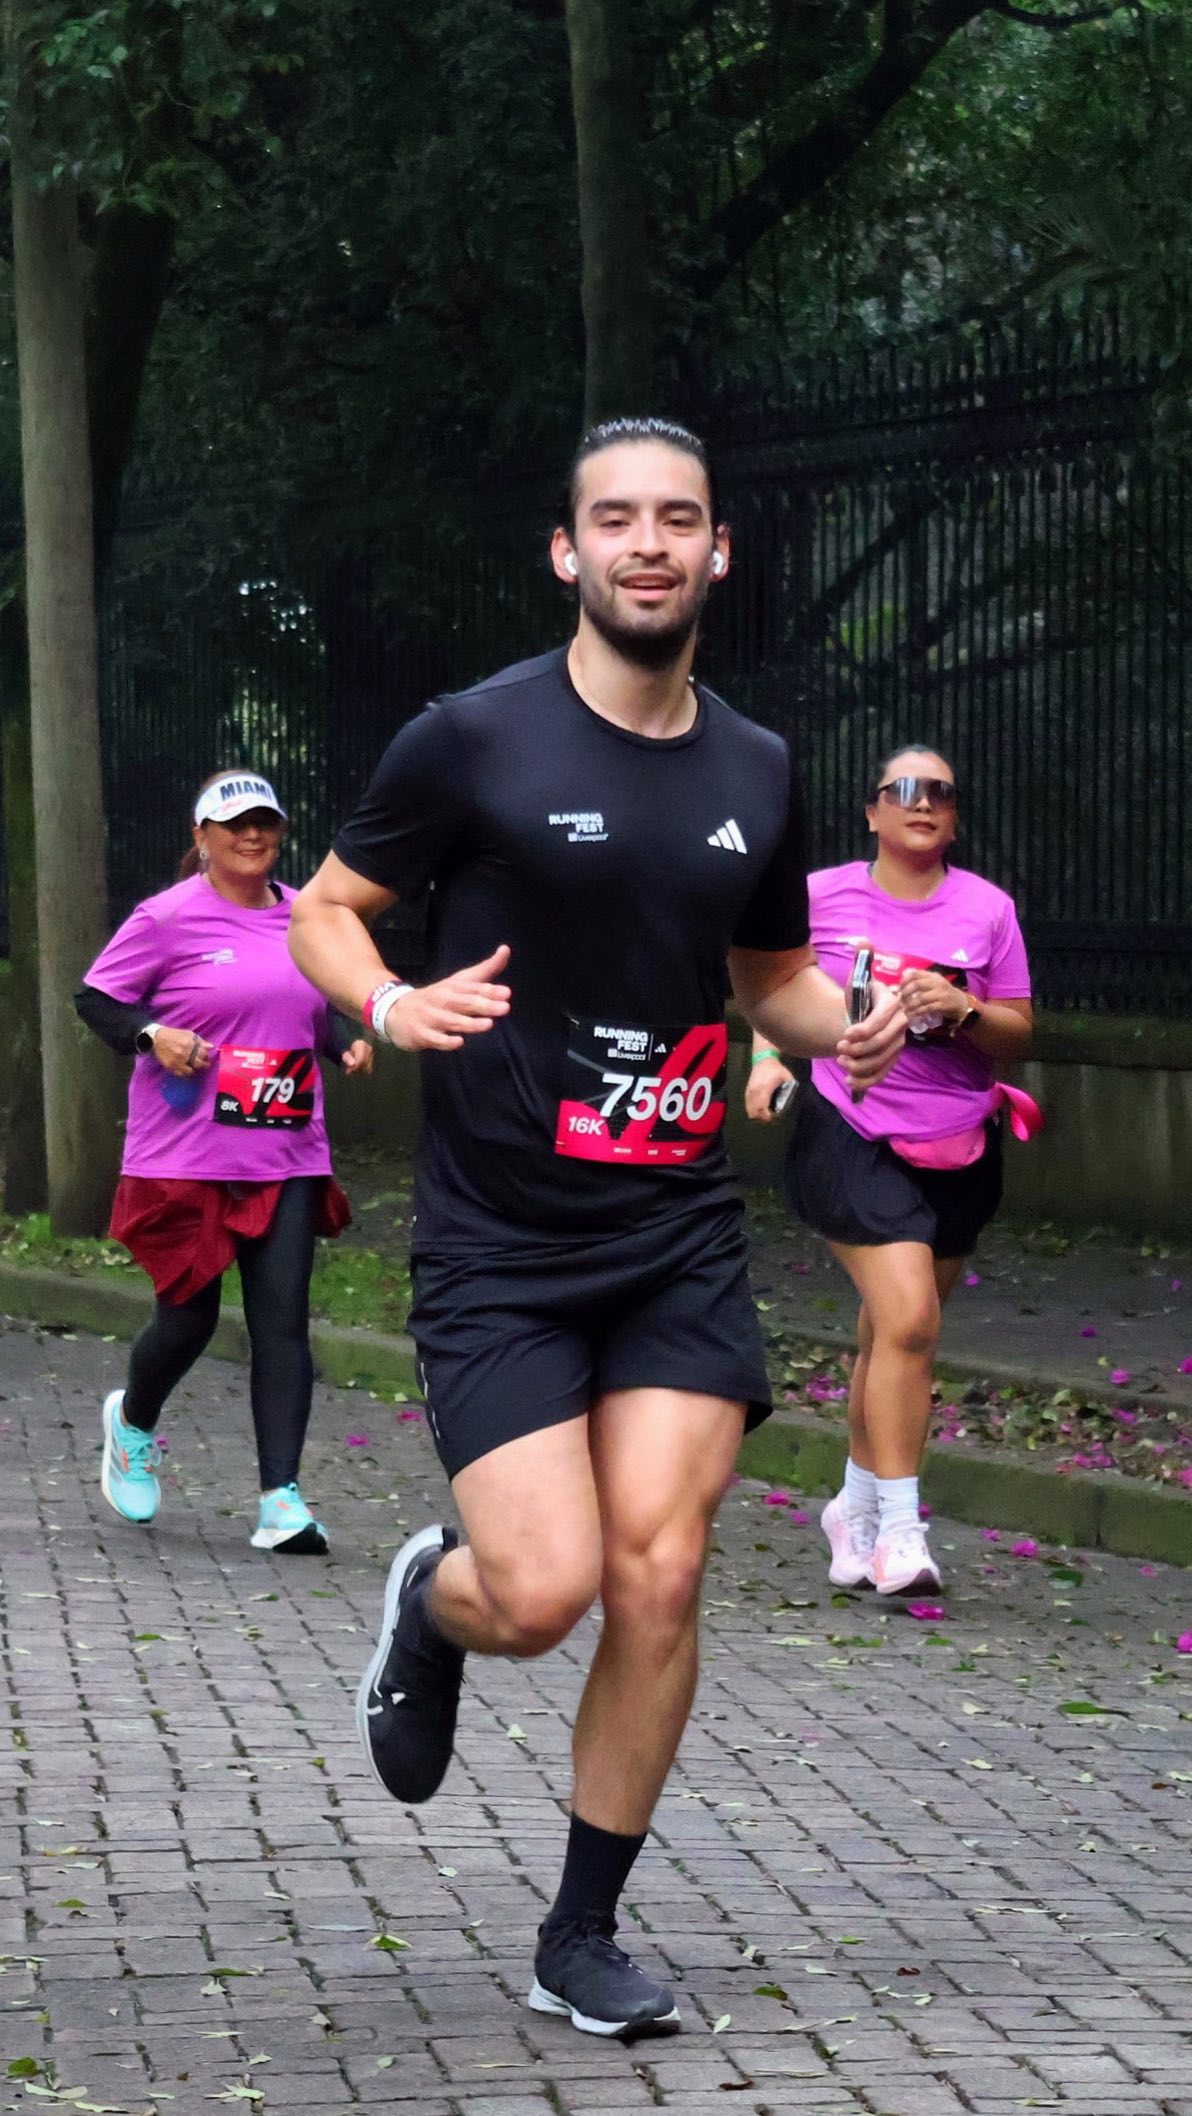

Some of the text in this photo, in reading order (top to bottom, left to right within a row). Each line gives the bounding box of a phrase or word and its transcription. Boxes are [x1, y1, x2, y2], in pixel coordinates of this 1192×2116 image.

[220, 781, 272, 800] MIAMI
[549, 813, 604, 825] RUNNING
[575, 823, 604, 833] FEST
[594, 1026, 648, 1042] RUNNING
[617, 1040, 648, 1052] FEST
[251, 1077, 295, 1104] 179
[600, 1073, 712, 1121] 7560
[220, 1100, 239, 1112] 8K
[568, 1116, 605, 1136] 16K
